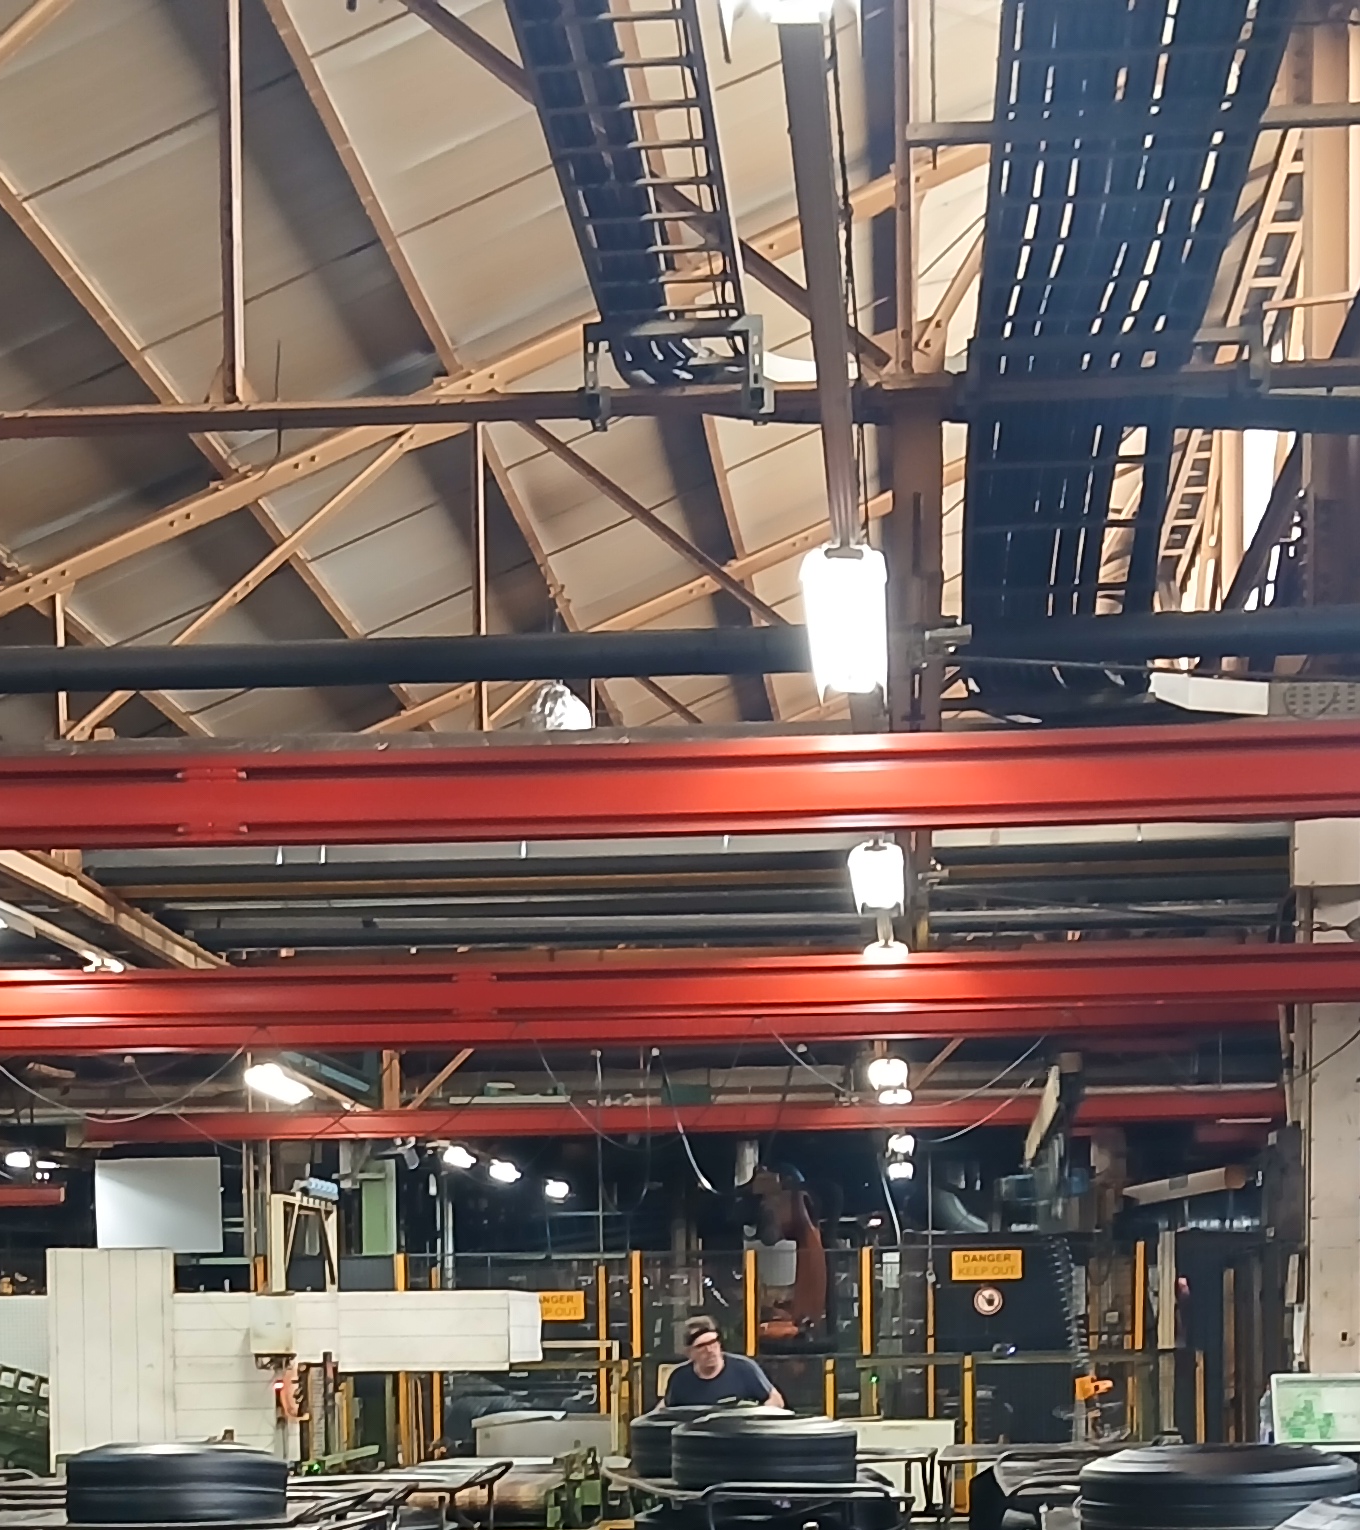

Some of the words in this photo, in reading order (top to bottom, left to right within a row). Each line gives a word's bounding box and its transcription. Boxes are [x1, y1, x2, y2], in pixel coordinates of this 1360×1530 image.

[962, 1253, 1012, 1264] DANGER
[958, 1266, 989, 1276] KEEP
[991, 1265, 1016, 1276] OUT
[539, 1294, 574, 1305] NGER
[554, 1306, 578, 1317] OUT
